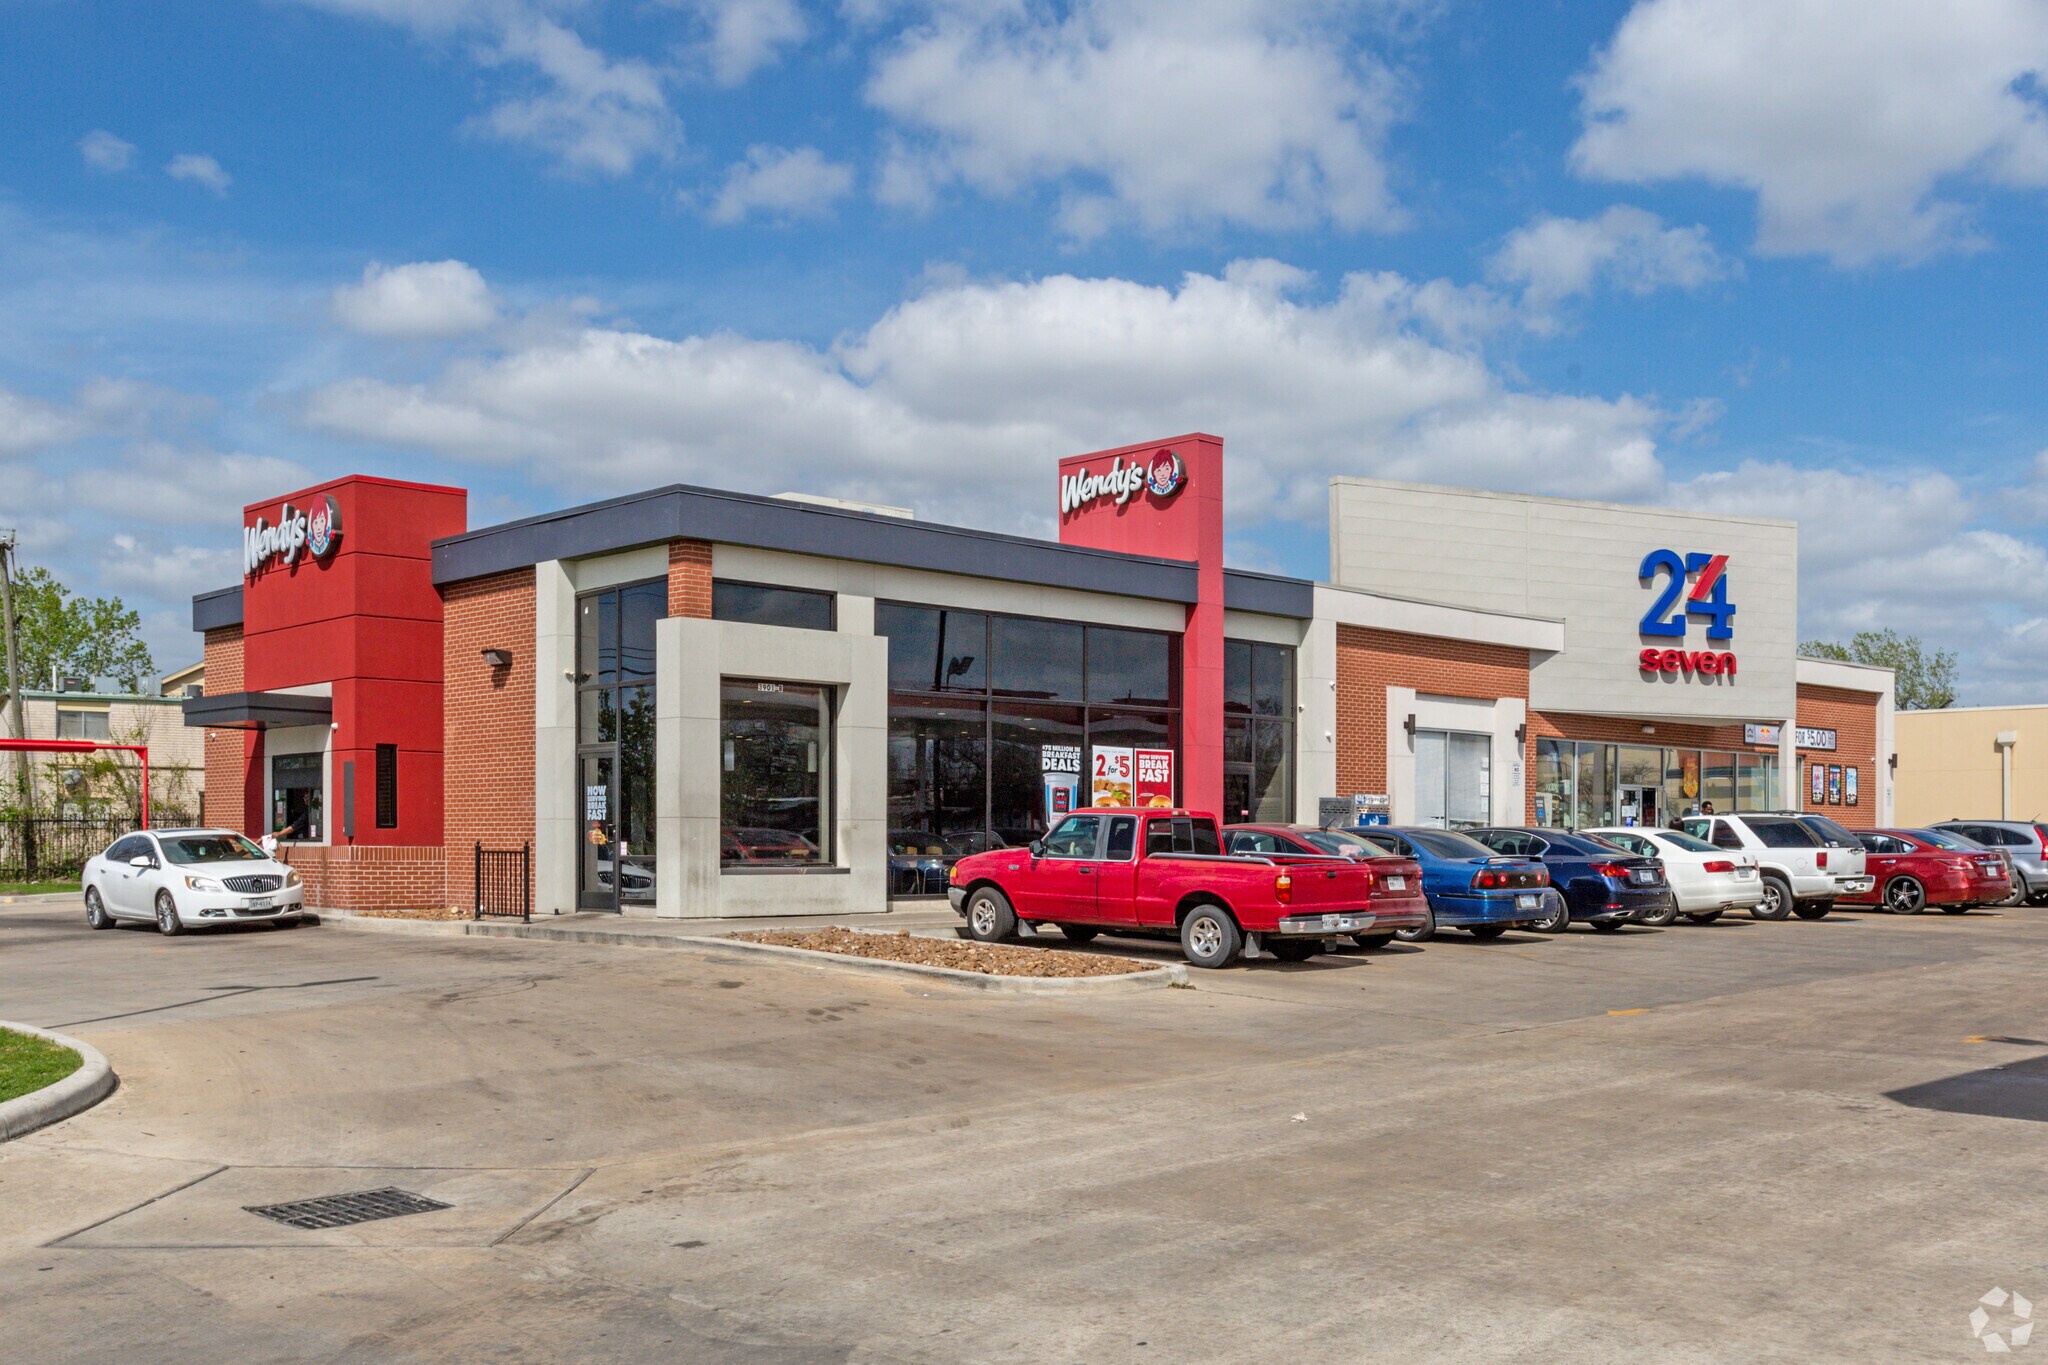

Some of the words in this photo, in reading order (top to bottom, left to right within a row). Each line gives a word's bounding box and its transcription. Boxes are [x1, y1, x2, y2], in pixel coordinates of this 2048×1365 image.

[1061, 457, 1143, 513] Wendy's
[244, 503, 306, 574] Wendy's
[1639, 648, 1737, 674] seven
[1807, 729, 1827, 747] $5.00
[1042, 751, 1080, 759] BREAKFAST
[1042, 758, 1080, 772] DEALS
[1095, 754, 1106, 776] 2
[1107, 765, 1118, 775] for
[1115, 755, 1130, 778] $5
[1139, 760, 1169, 769] BREAK
[1139, 769, 1169, 783] FAST
[587, 785, 607, 796] NOW
[587, 801, 607, 810] BREAK
[587, 809, 607, 820] FAST
